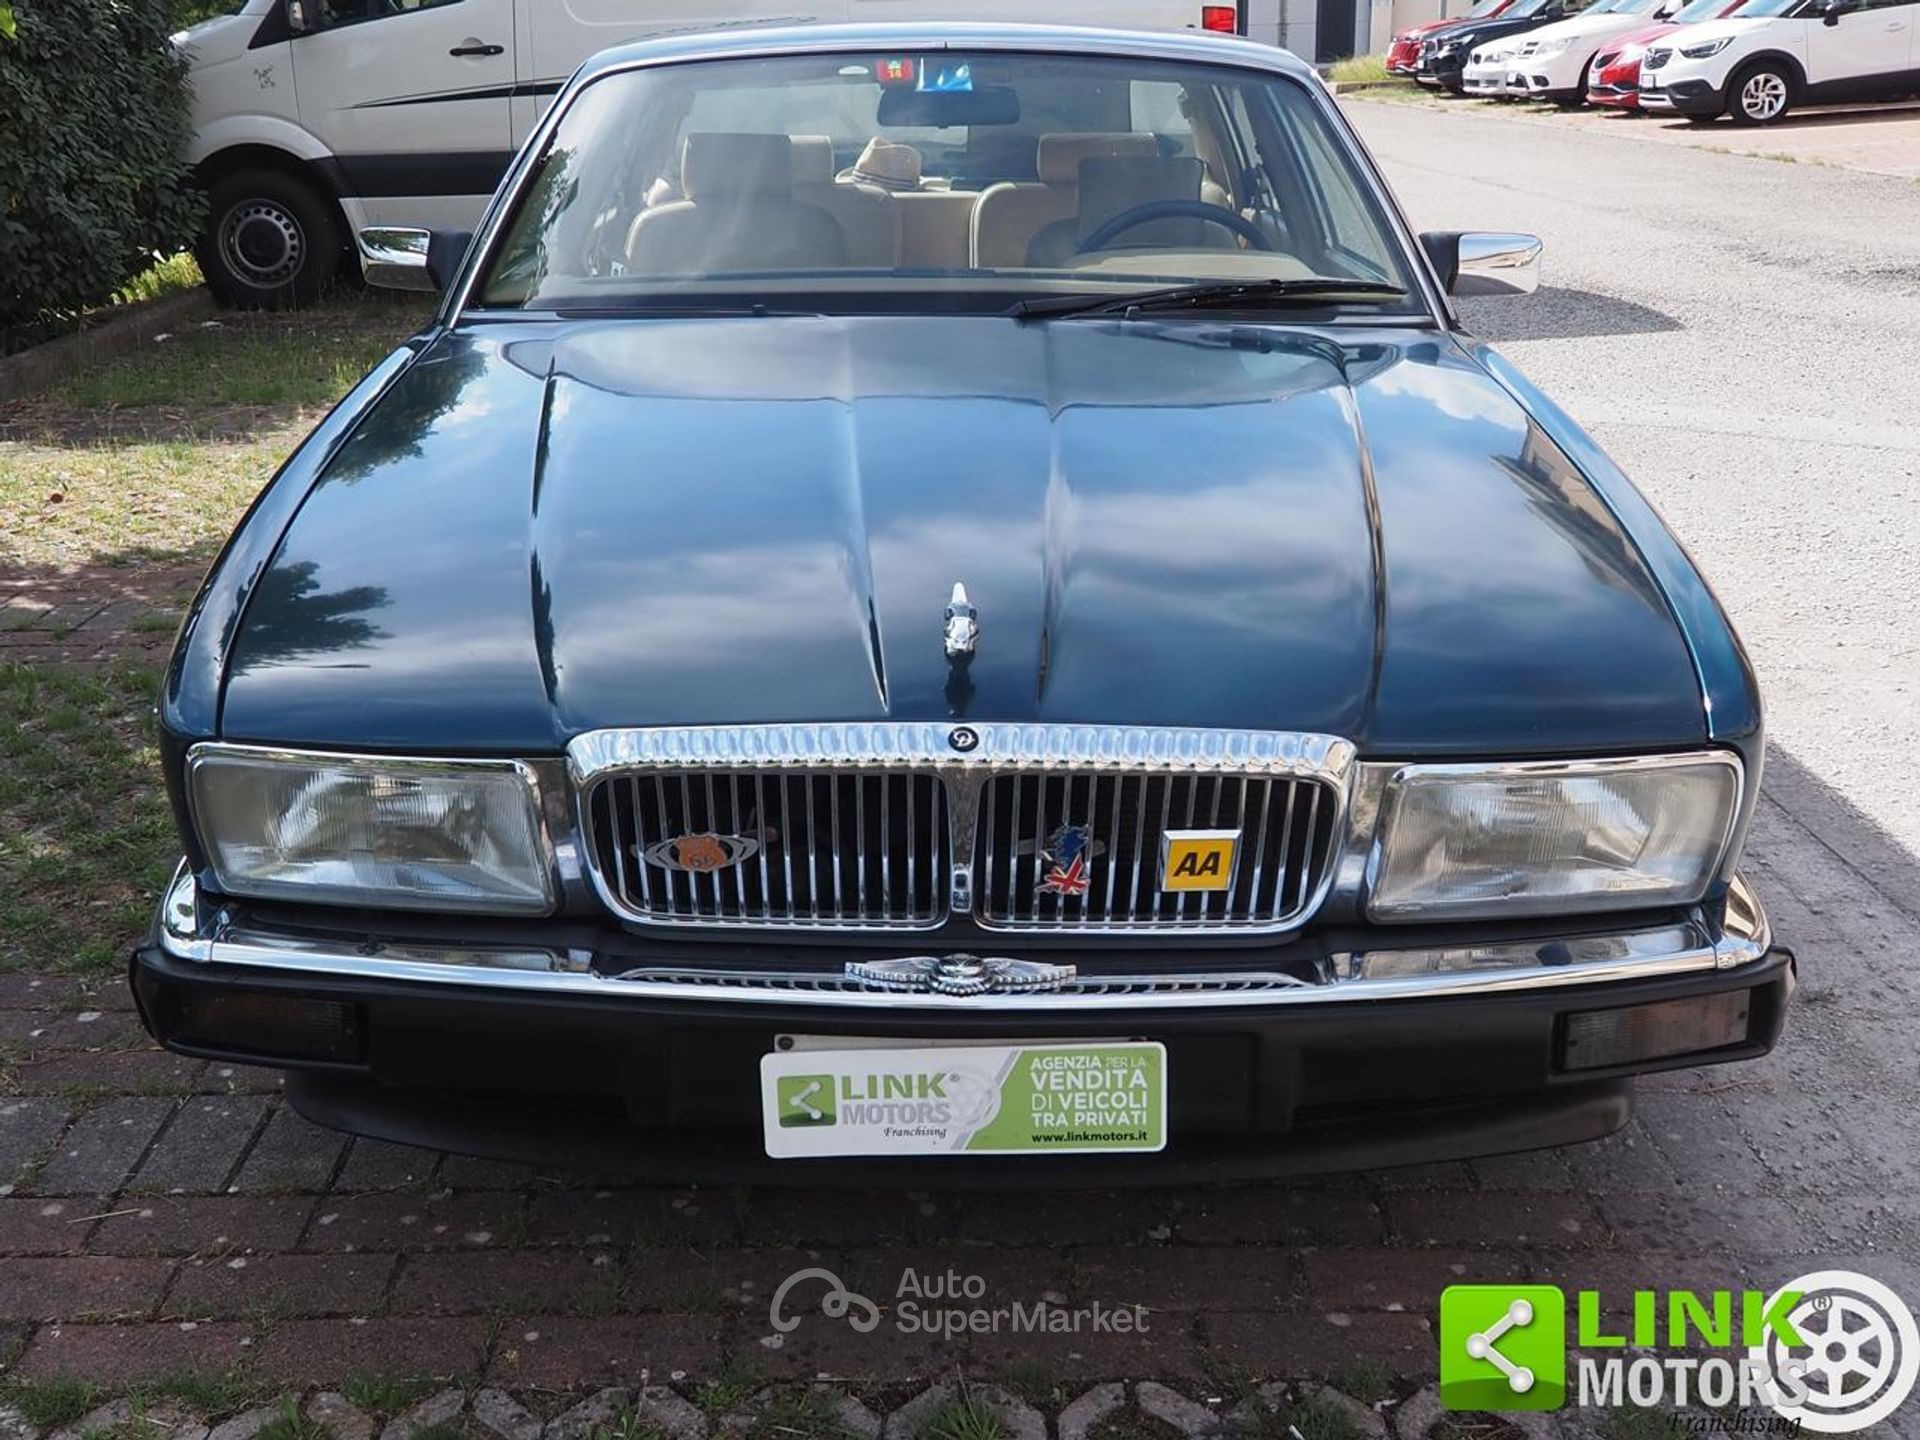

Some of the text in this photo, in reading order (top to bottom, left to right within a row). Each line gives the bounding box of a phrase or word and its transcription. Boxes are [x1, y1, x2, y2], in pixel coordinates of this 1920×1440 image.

[1173, 851, 1221, 877] AA
[1030, 1055, 1101, 1070] AGENZIA
[1130, 1056, 1146, 1068] LA
[841, 1073, 947, 1099] LINK
[1030, 1069, 1147, 1091] VENDITA
[1031, 1091, 1147, 1111] DI VEICOLI
[842, 1102, 951, 1125] MOTORS
[1031, 1110, 1147, 1127] TRA PRIVATI
[883, 1126, 947, 1138] Franchising
[1032, 1131, 1147, 1143] www.linkmotors.it
